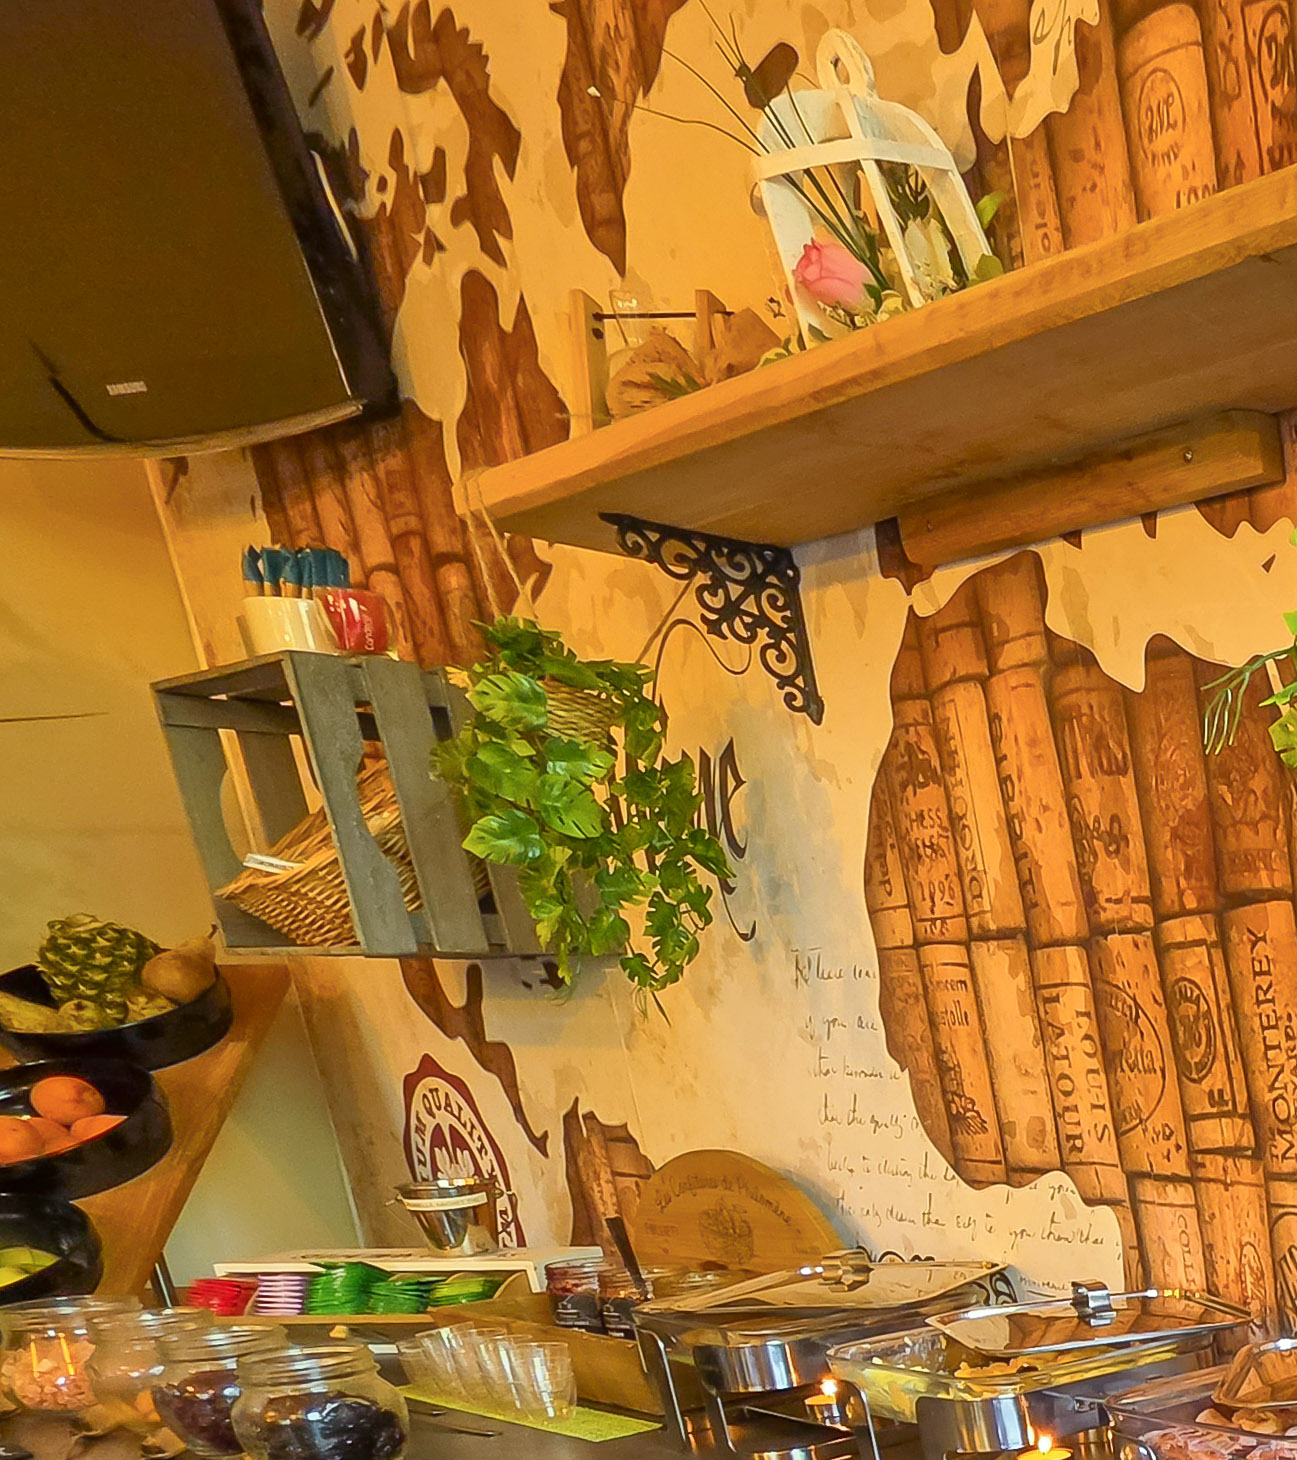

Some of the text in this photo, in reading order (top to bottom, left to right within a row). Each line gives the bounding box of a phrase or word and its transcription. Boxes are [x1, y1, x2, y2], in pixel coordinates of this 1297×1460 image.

[1041, 992, 1084, 1154] LATOUR
[1075, 1010, 1111, 1143] LOUIS
[1246, 927, 1297, 1162] MONTEREY
